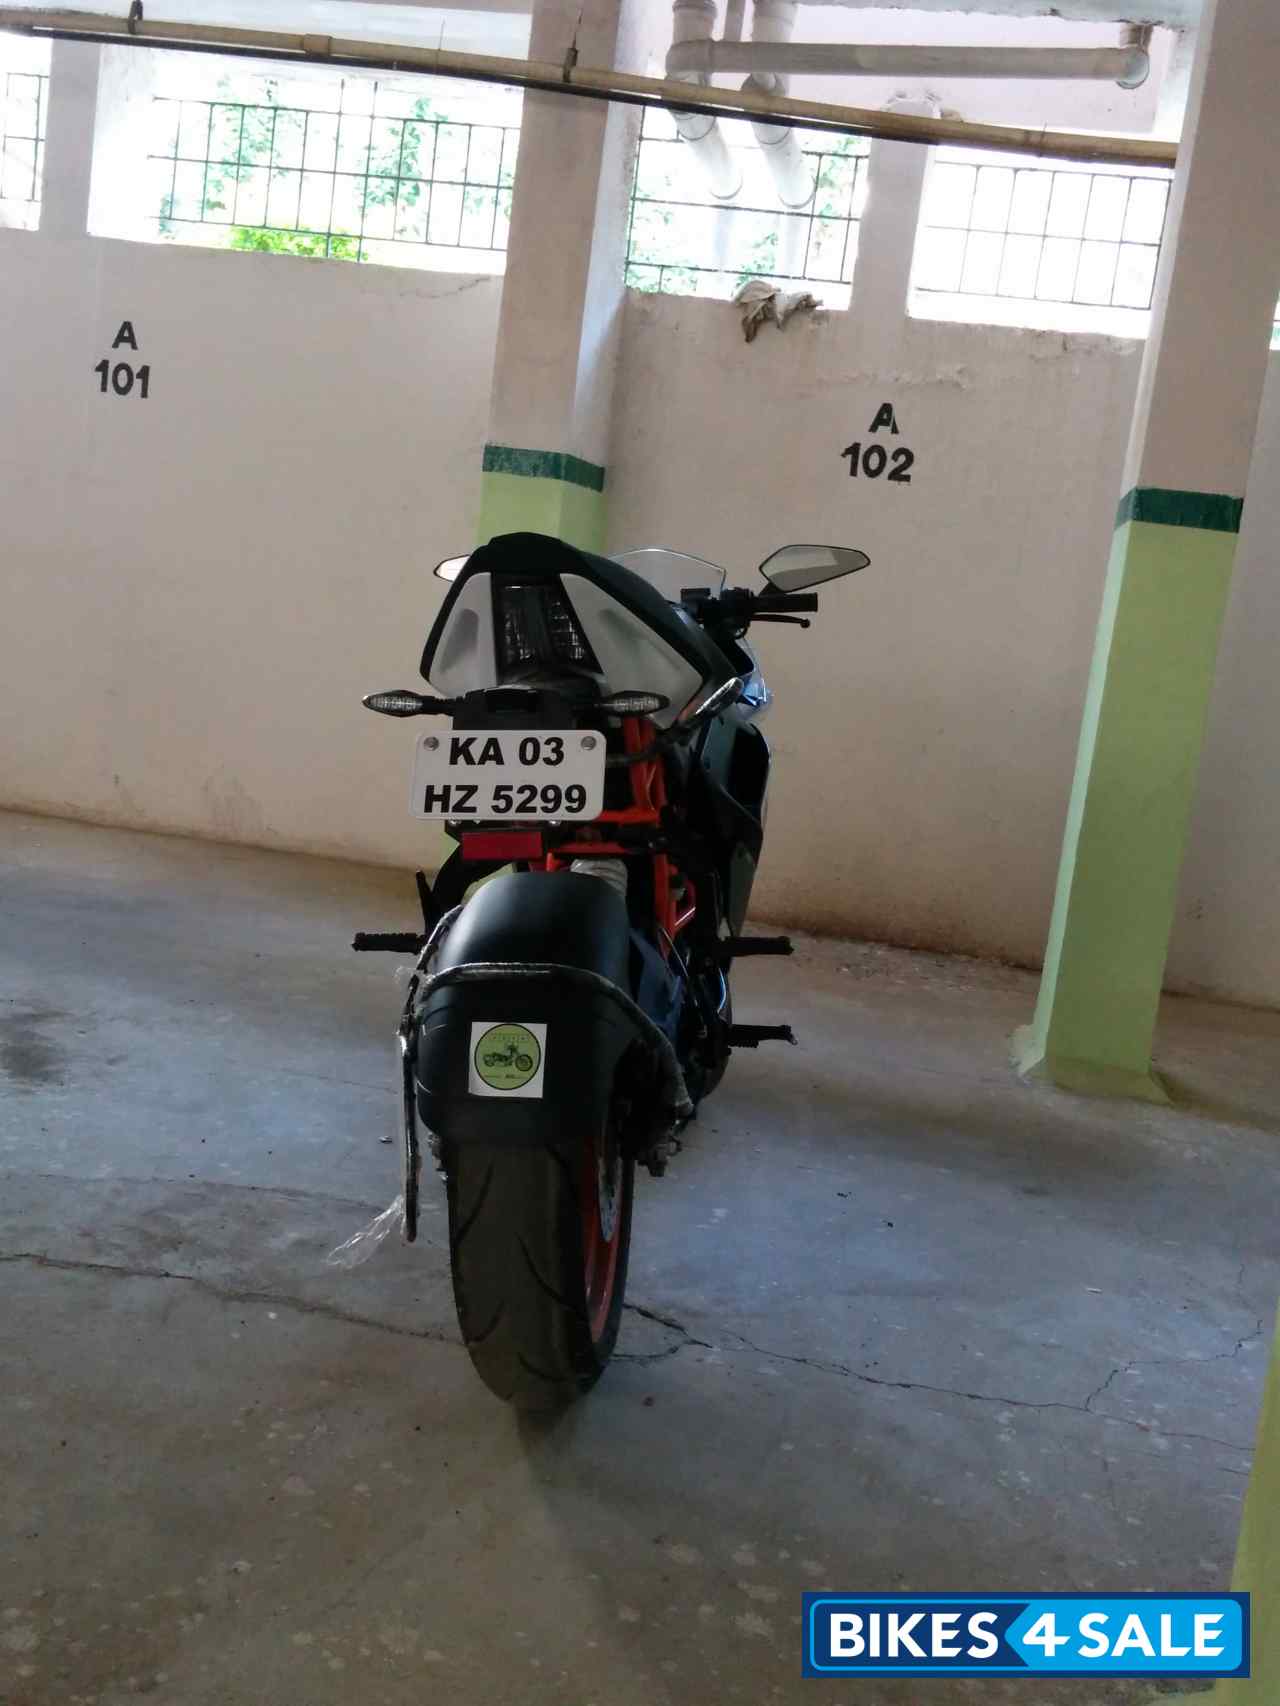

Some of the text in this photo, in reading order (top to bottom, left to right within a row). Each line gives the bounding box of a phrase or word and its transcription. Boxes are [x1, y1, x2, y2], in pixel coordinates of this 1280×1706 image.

[111, 320, 139, 351] A
[94, 359, 151, 399] 101
[868, 402, 900, 435] A
[840, 441, 915, 483] 102
[448, 736, 565, 767] KA 03
[423, 783, 587, 814] HZ 5299
